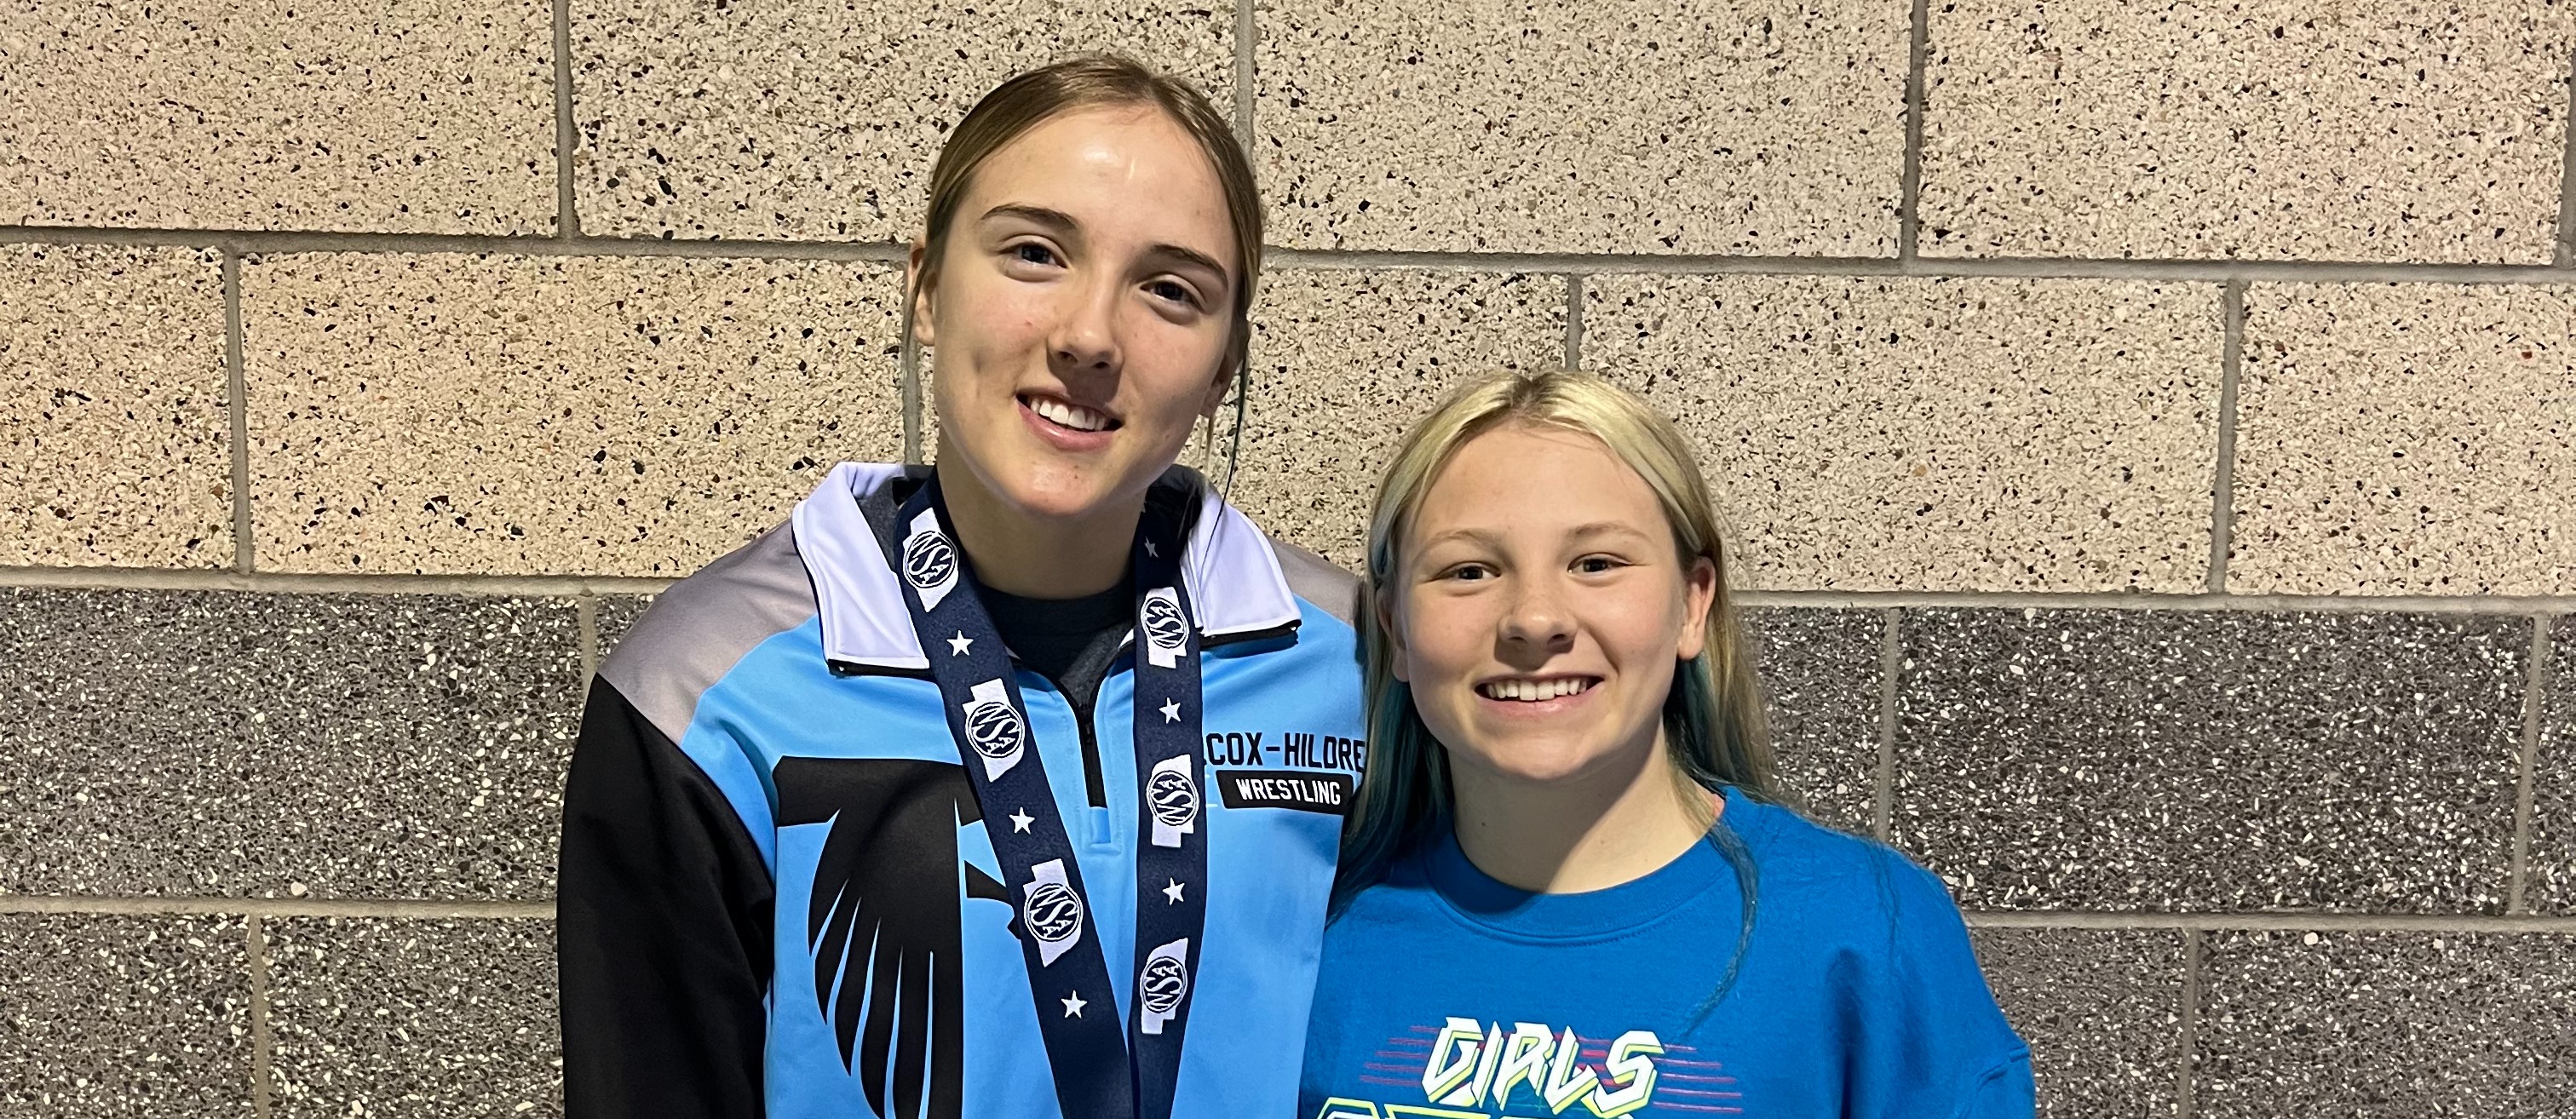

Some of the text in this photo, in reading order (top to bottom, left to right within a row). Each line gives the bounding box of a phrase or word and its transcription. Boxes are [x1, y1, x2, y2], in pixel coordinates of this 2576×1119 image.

[1202, 732, 1366, 773] COX-HILDRE
[1235, 778, 1341, 806] WRESTLING
[1421, 1016, 1665, 1118] GIRLS
